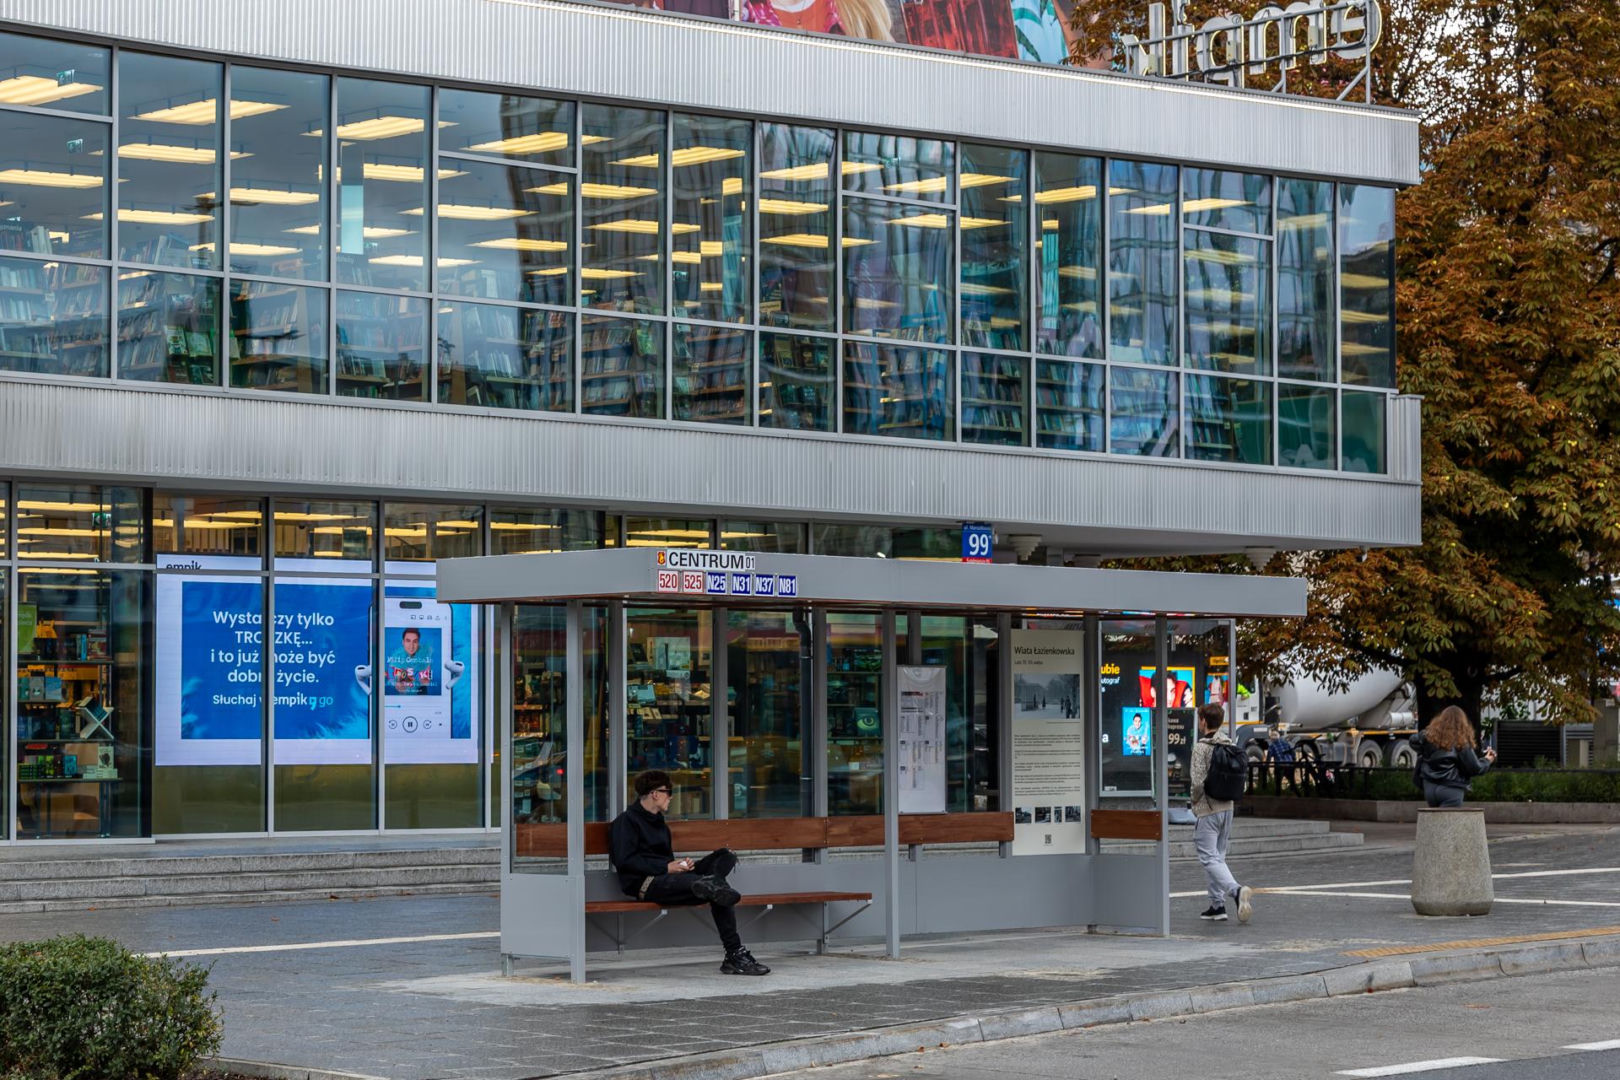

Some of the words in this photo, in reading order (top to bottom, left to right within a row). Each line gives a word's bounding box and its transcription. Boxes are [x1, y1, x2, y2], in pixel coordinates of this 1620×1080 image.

[968, 533, 989, 556] 99
[668, 551, 744, 569] CENTRUM
[745, 557, 755, 569] 01
[659, 573, 678, 589] 520
[684, 574, 702, 590] 525
[707, 574, 726, 591] N25
[732, 575, 751, 592] N31
[755, 576, 774, 593] N37
[779, 577, 797, 594] N81
[297, 612, 335, 628] tylko
[234, 630, 313, 647] TROZKĘ...
[210, 649, 215, 662] i
[218, 650, 234, 663] to
[237, 649, 259, 667] już
[273, 650, 304, 664] oże
[308, 651, 336, 668] być
[1014, 646, 1033, 655] Wiata
[1034, 647, 1075, 656] Łazienkowska
[276, 669, 319, 686] życie.
[1100, 663, 1120, 675] ubie
[212, 694, 257, 707] Słuchaj
